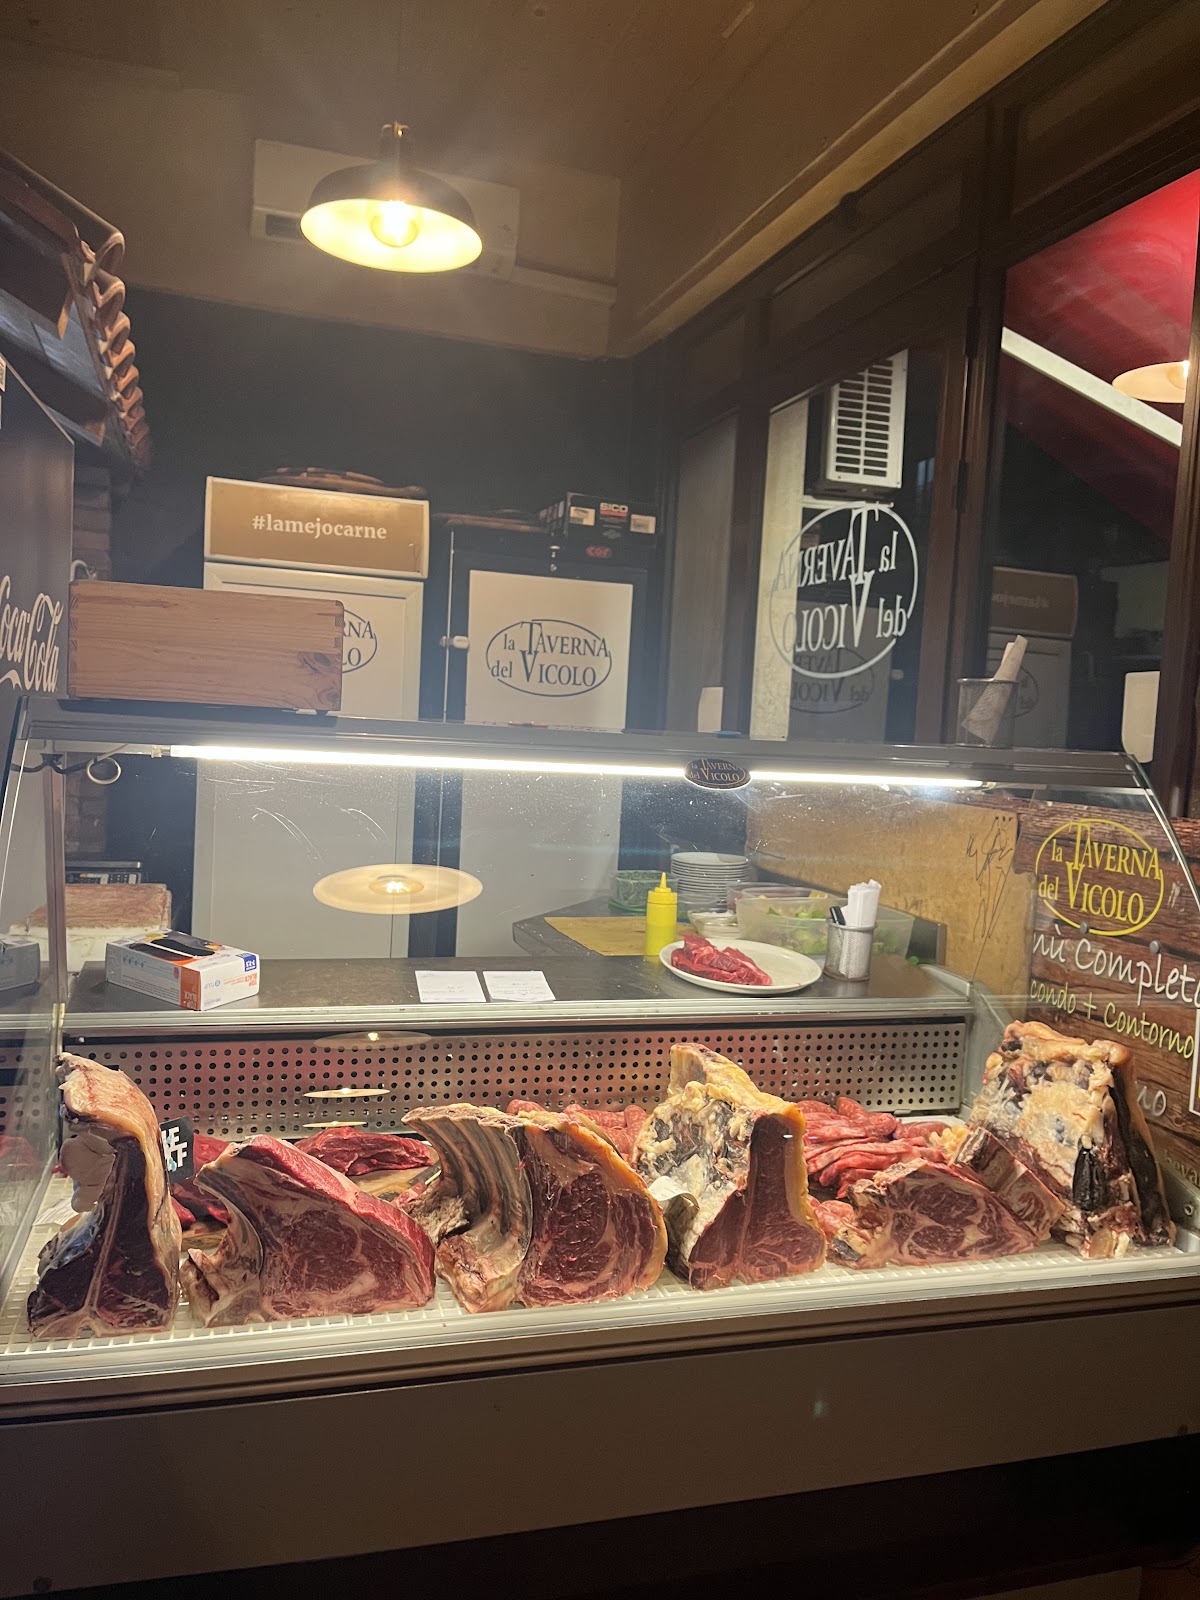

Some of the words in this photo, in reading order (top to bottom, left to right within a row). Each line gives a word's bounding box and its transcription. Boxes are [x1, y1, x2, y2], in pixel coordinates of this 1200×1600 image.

[252, 513, 388, 540] #lamejocarne
[503, 633, 516, 651] la
[520, 621, 610, 658] TAVERNA
[490, 660, 513, 679] del
[519, 650, 597, 688] VICOLO
[700, 767, 740, 781] VICOLO
[1051, 838, 1063, 863] la
[1068, 822, 1162, 881] TAVERNA
[1038, 874, 1060, 901] del
[1065, 861, 1145, 925] VICOLO
[1103, 1001, 1195, 1059] Contorno
